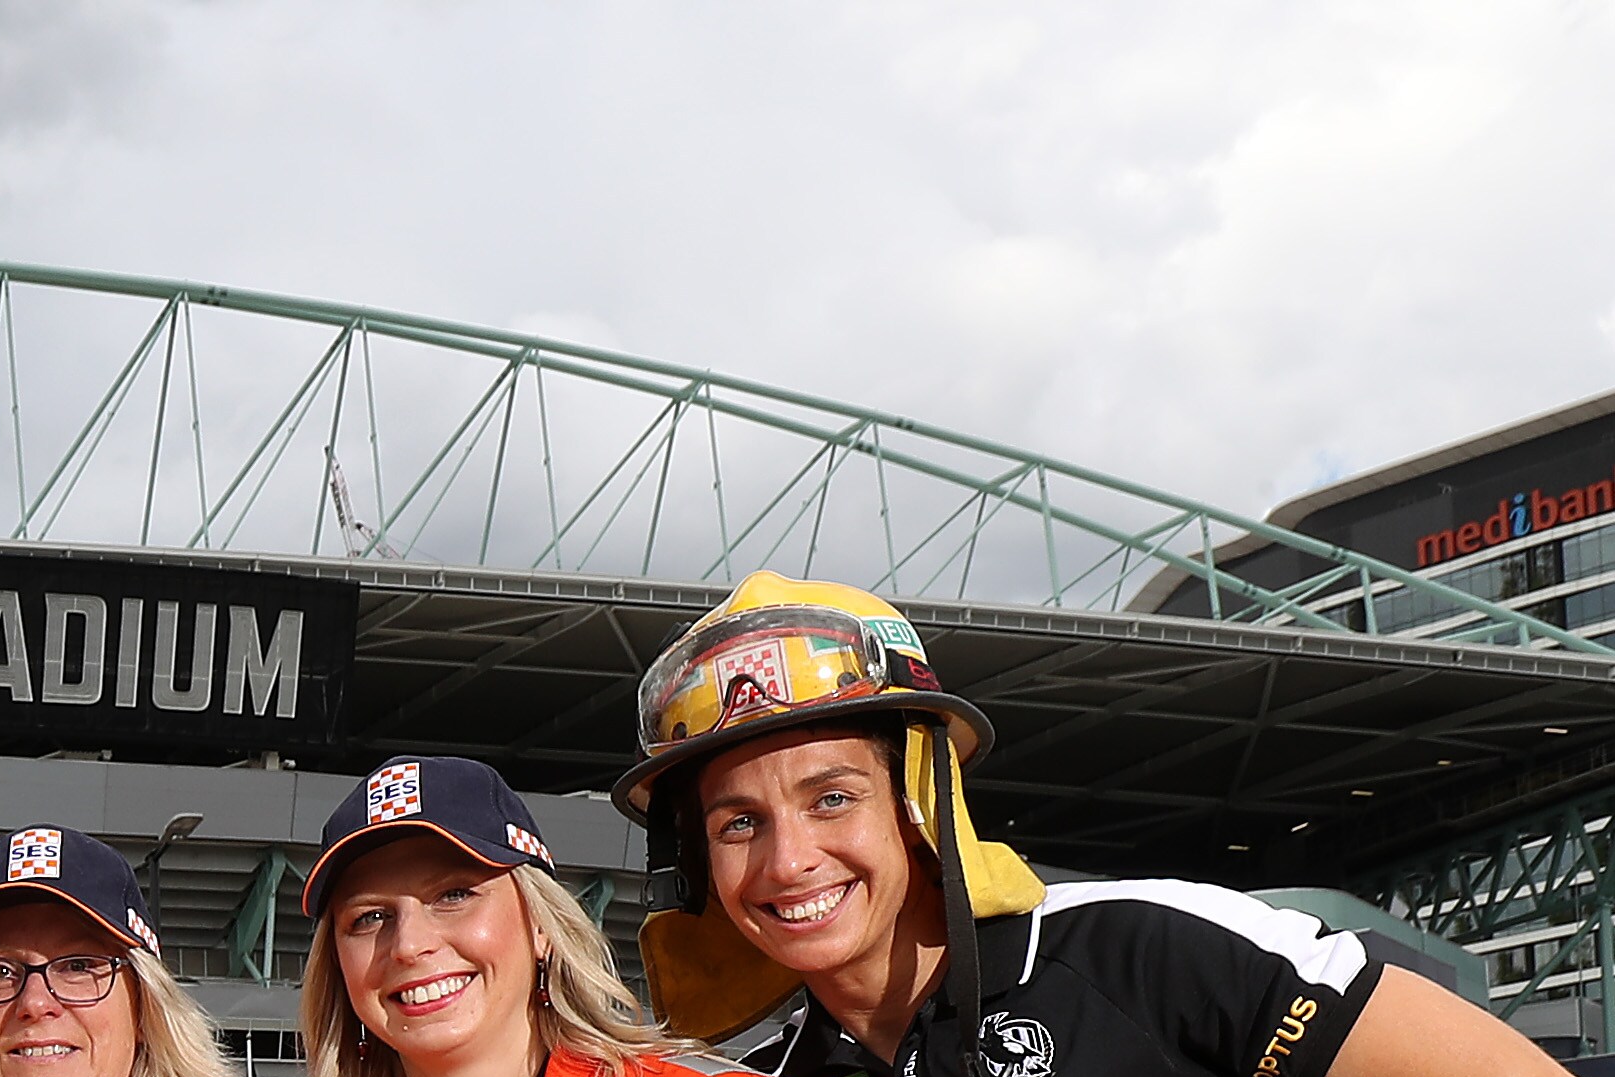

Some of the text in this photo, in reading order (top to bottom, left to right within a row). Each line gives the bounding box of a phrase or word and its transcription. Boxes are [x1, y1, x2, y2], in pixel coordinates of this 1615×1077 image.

[1416, 464, 1615, 566] mediban
[369, 780, 417, 806] SES
[11, 845, 58, 860] SES
